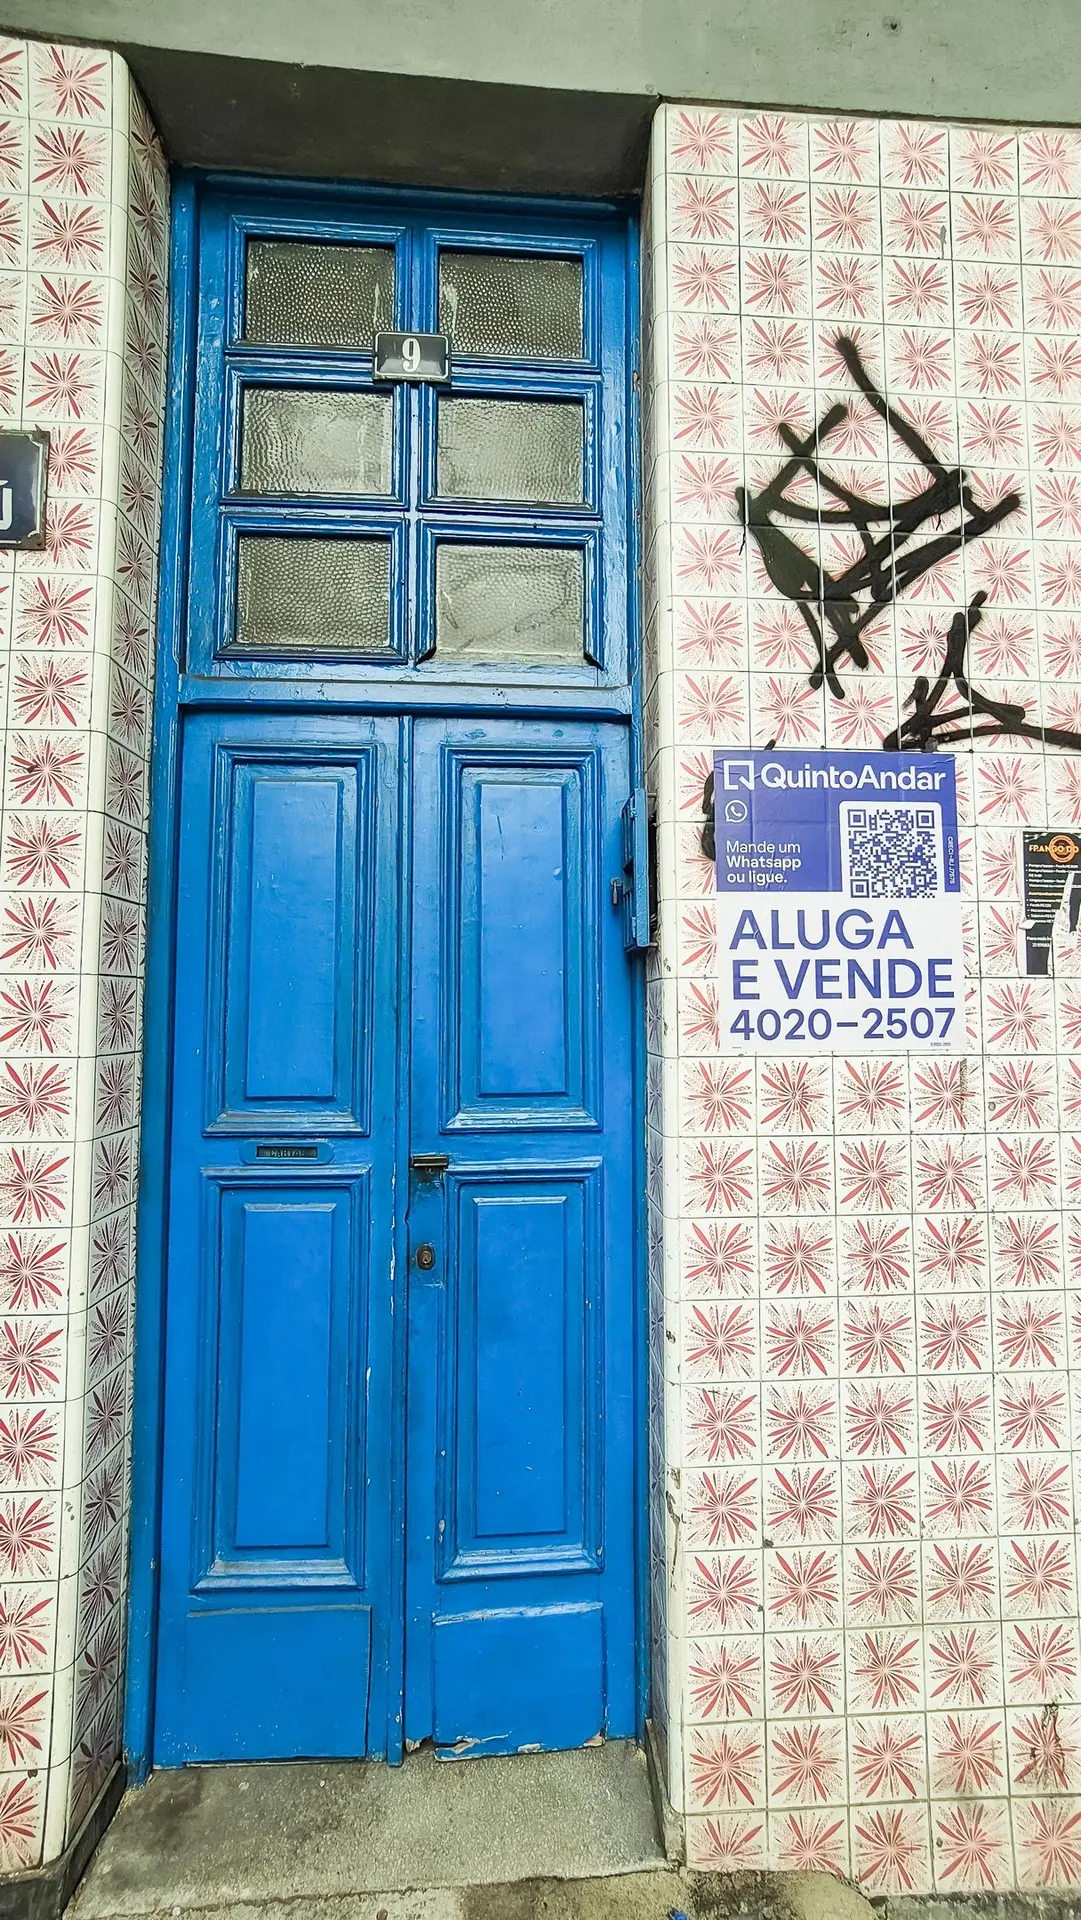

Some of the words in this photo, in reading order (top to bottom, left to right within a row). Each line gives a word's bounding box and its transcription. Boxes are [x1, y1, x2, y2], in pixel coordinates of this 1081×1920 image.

[402, 338, 421, 372] 9
[761, 763, 946, 790] QuintoAndar
[726, 840, 775, 853] Mande
[778, 843, 801, 853] um
[726, 855, 802, 871] Whatsapp
[726, 872, 747, 884] ou
[749, 870, 788, 887] ligue.
[729, 909, 914, 950] ALUGA
[732, 960, 760, 1000] E
[774, 959, 955, 999] VENDE
[730, 1007, 956, 1040] 4020-2507
